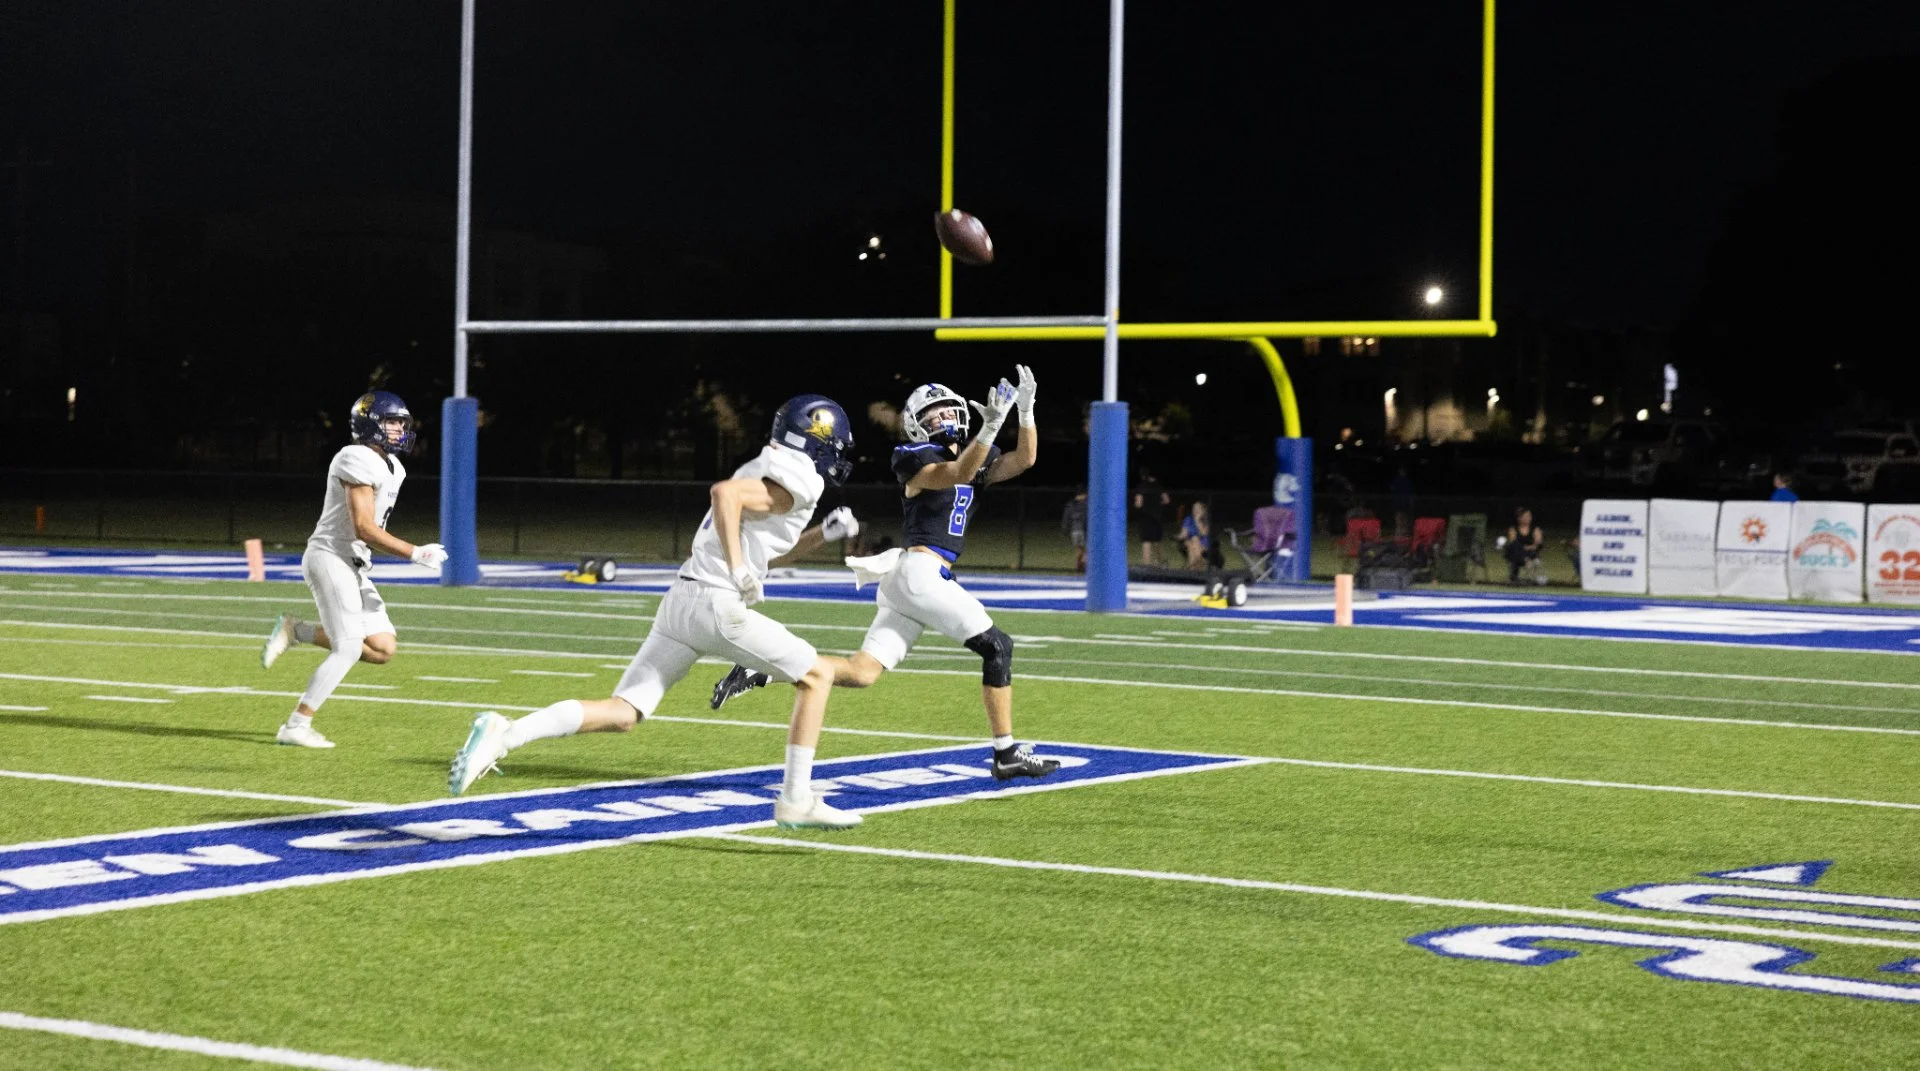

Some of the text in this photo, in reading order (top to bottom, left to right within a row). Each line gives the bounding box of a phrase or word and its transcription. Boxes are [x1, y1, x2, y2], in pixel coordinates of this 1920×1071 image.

[948, 484, 974, 536] 8
[0, 844, 281, 894] EN
[288, 789, 780, 851] CRAIN
